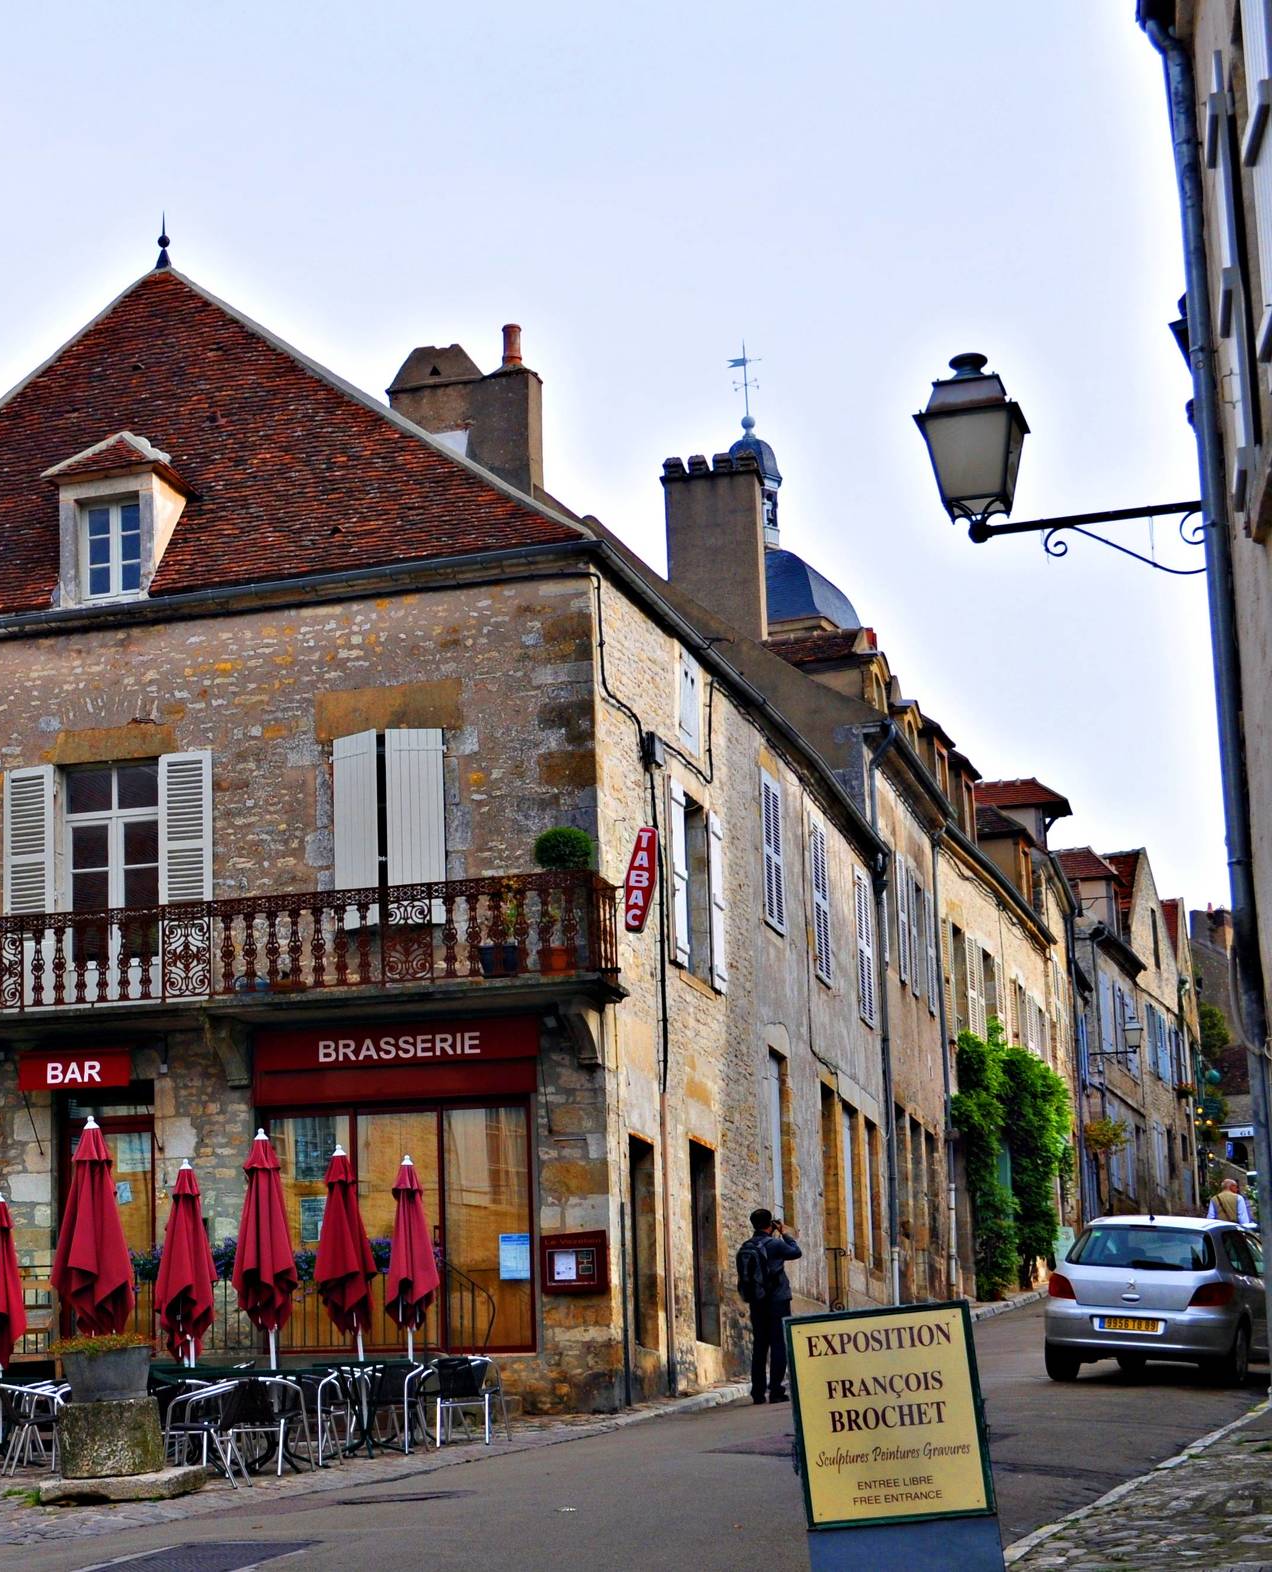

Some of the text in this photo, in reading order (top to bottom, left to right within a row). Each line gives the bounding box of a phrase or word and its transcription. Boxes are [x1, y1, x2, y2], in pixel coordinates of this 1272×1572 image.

[626, 831, 652, 926] TABAC
[318, 1032, 481, 1063] BRASSERIE
[46, 1061, 101, 1084] BAR
[806, 1322, 952, 1357] EXPOSITION
[826, 1370, 943, 1399] FRANÇOIS
[828, 1401, 946, 1433] BROCHET
[815, 1442, 971, 1473] Sculptures Peintures Gravures
[853, 1490, 942, 1505] FREE ENTRANCE
[857, 1475, 933, 1491] ENTREE LIBRE
